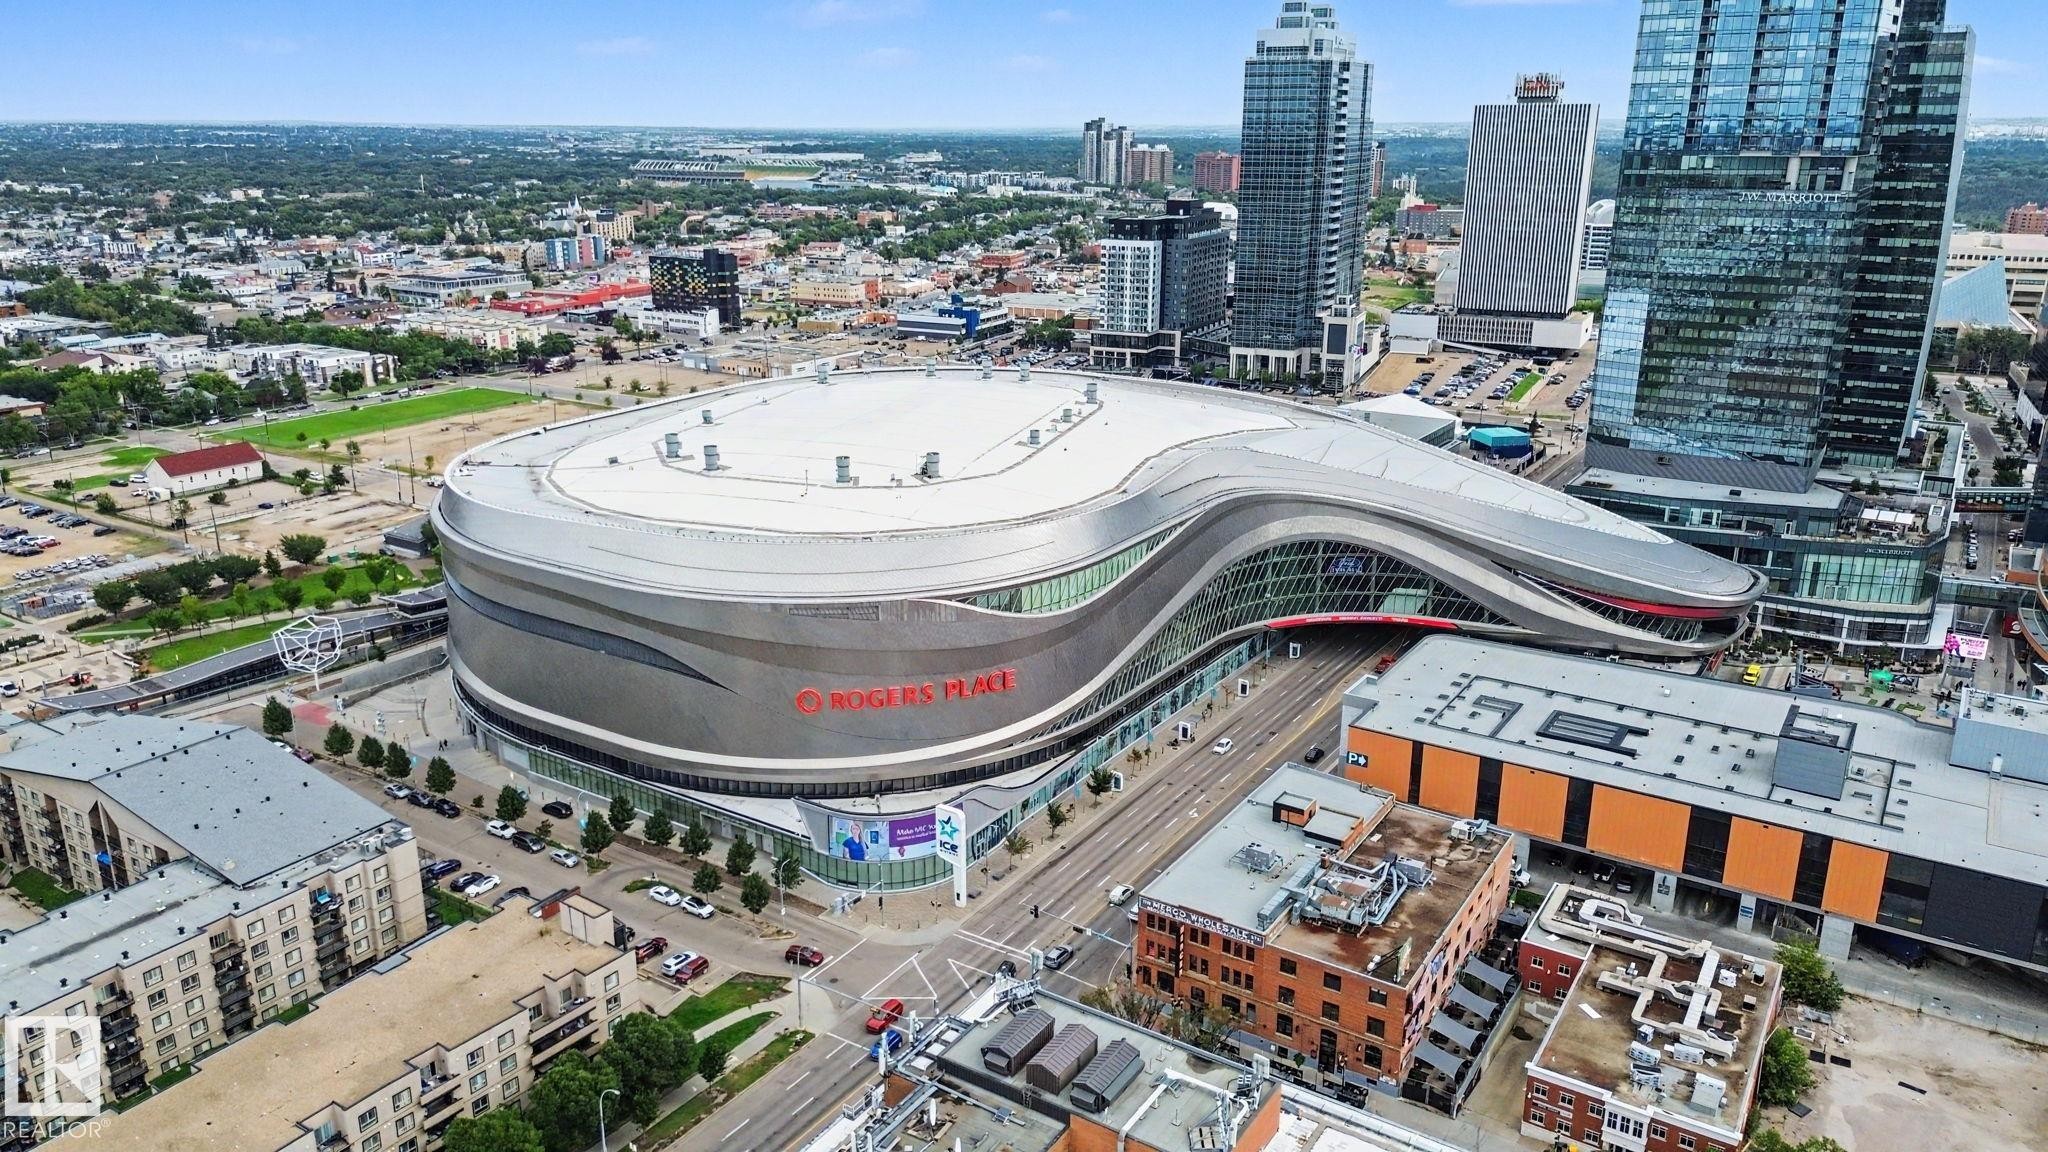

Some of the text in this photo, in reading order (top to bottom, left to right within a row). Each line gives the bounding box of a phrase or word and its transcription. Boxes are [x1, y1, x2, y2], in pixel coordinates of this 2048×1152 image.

[1739, 192, 1841, 204] JW MARRIOTT
[829, 668, 1017, 711] ROGERS PLACE
[1348, 752, 1358, 764] P
[940, 840, 959, 853] ICE
[1190, 913, 1248, 938] WHOLESALE
